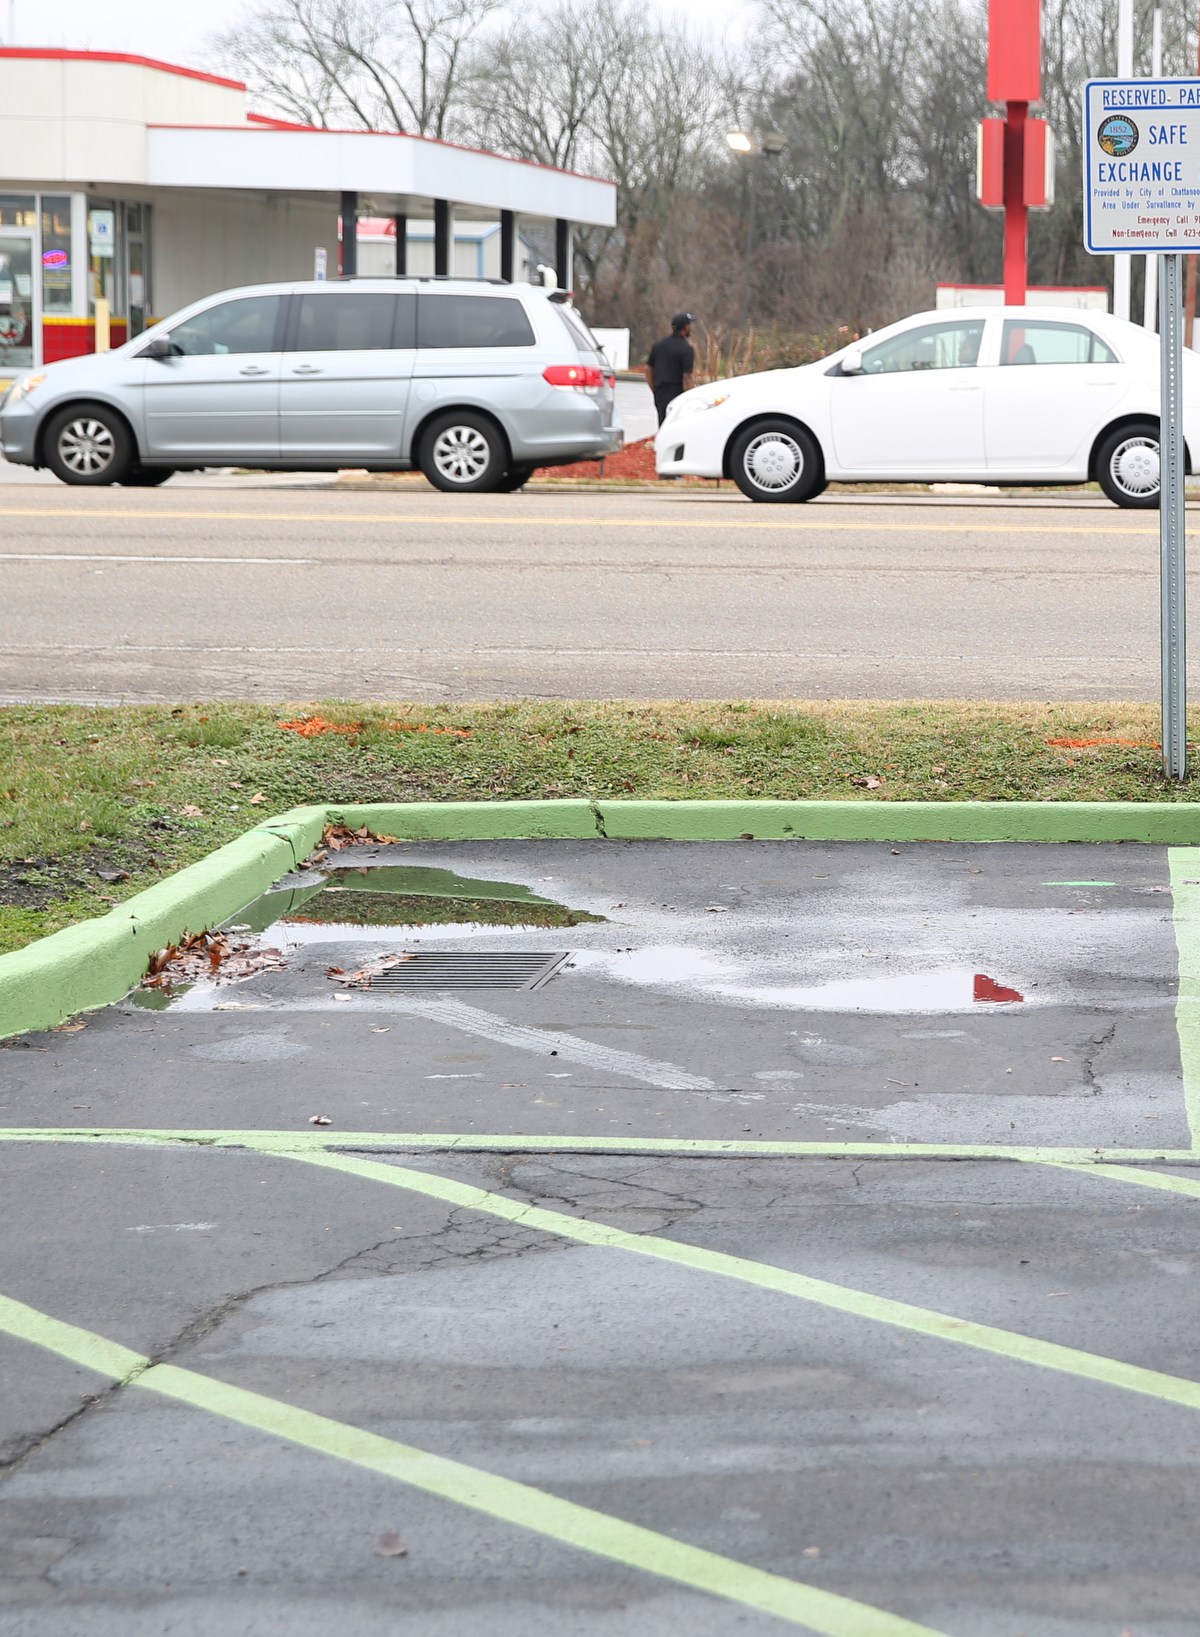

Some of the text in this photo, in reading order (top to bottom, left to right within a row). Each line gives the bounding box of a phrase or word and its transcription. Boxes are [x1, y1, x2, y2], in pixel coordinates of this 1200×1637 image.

[1102, 89, 1166, 106] RESERVED
[1109, 125, 1128, 134] 1852
[1148, 125, 1188, 145] SAFE
[1098, 161, 1183, 182] EXCHANGE
[1093, 188, 1120, 197] Provided
[1125, 188, 1133, 198] by
[1139, 187, 1152, 198] City
[1158, 187, 1164, 196] of
[1102, 201, 1116, 209] Area
[1121, 200, 1140, 209] Under
[1187, 200, 1195, 210] by
[1137, 215, 1170, 226] Emergency
[1176, 215, 1189, 224] Call
[1112, 229, 1160, 239] Non-Emergency
